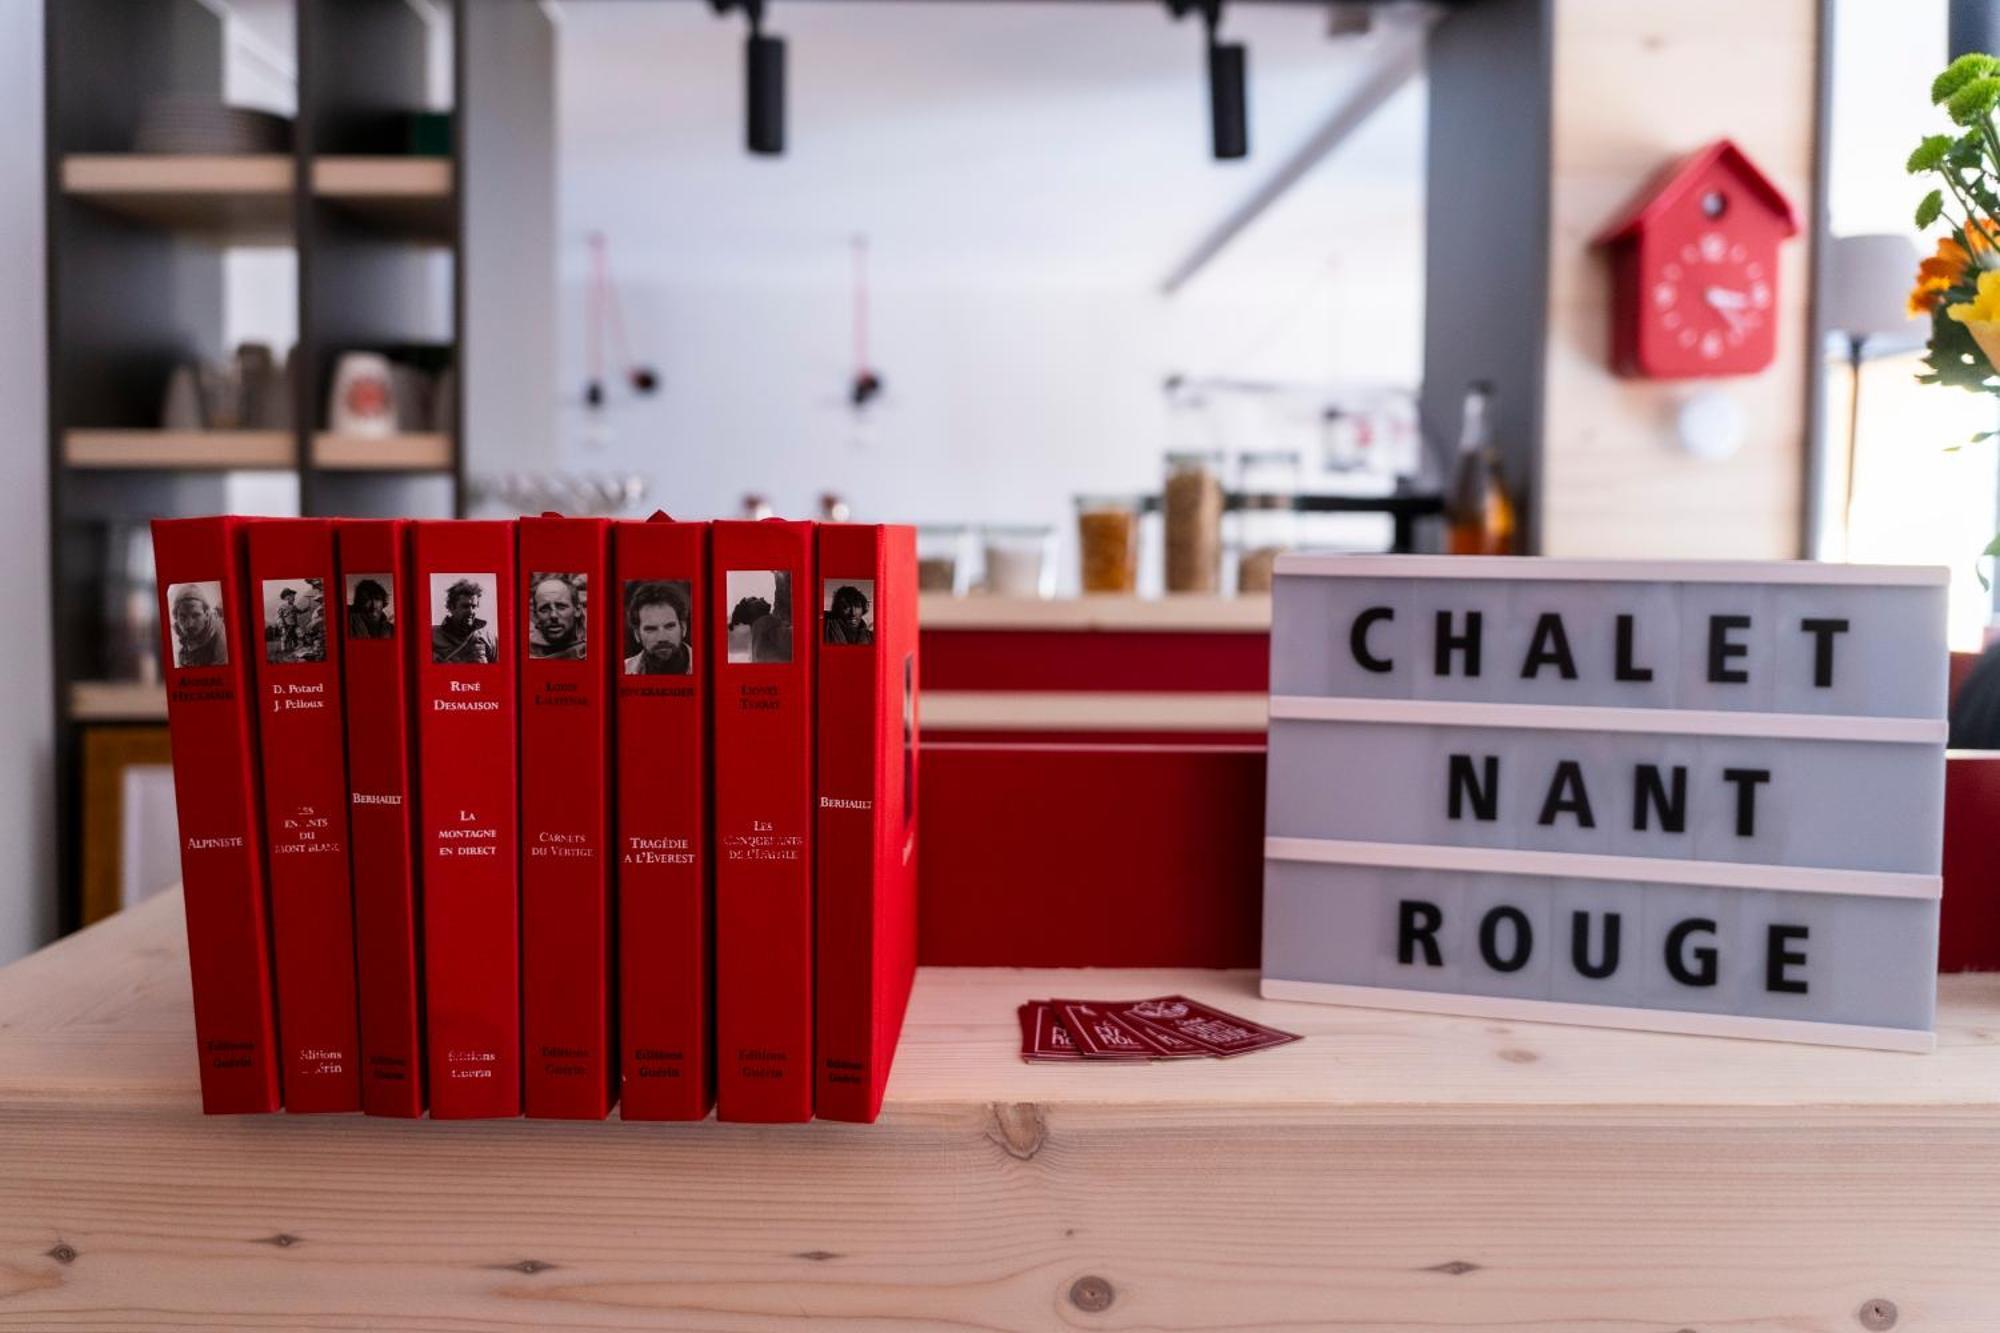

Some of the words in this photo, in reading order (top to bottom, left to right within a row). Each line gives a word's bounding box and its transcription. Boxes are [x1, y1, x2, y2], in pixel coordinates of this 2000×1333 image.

[1349, 606, 1850, 688] CHALET
[272, 684, 286, 695] D.
[288, 683, 324, 694] Potard
[1447, 753, 1771, 837] NANT
[438, 829, 497, 839] MONTAGNE
[439, 846, 453, 856] EN
[458, 846, 497, 856] DIRECT
[1398, 899, 1811, 994] ROUGE
